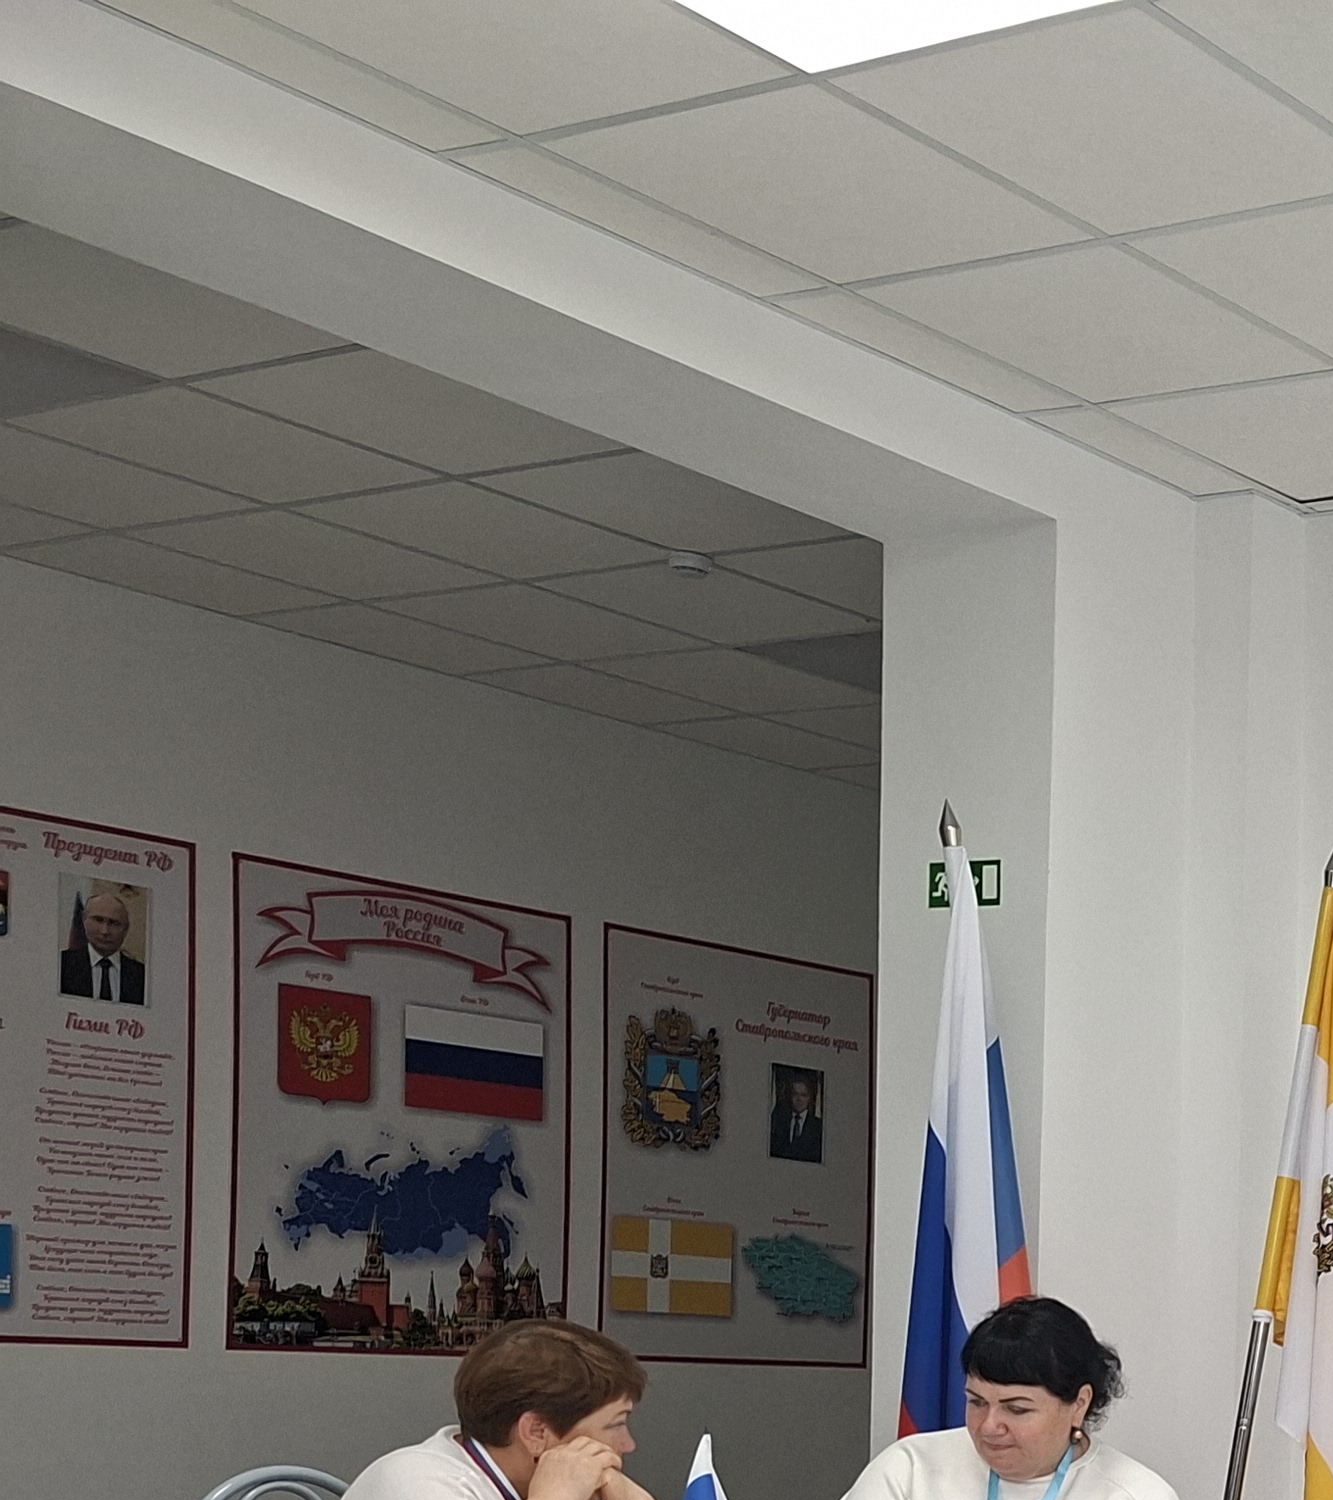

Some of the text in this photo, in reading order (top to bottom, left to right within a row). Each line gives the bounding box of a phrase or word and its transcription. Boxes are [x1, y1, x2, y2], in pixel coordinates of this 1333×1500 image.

[42, 830, 140, 866] Президент
[143, 850, 174, 873] РФ
[360, 898, 465, 935] Моя родина
[383, 920, 444, 948] Россия
[115, 1018, 145, 1039] РФ
